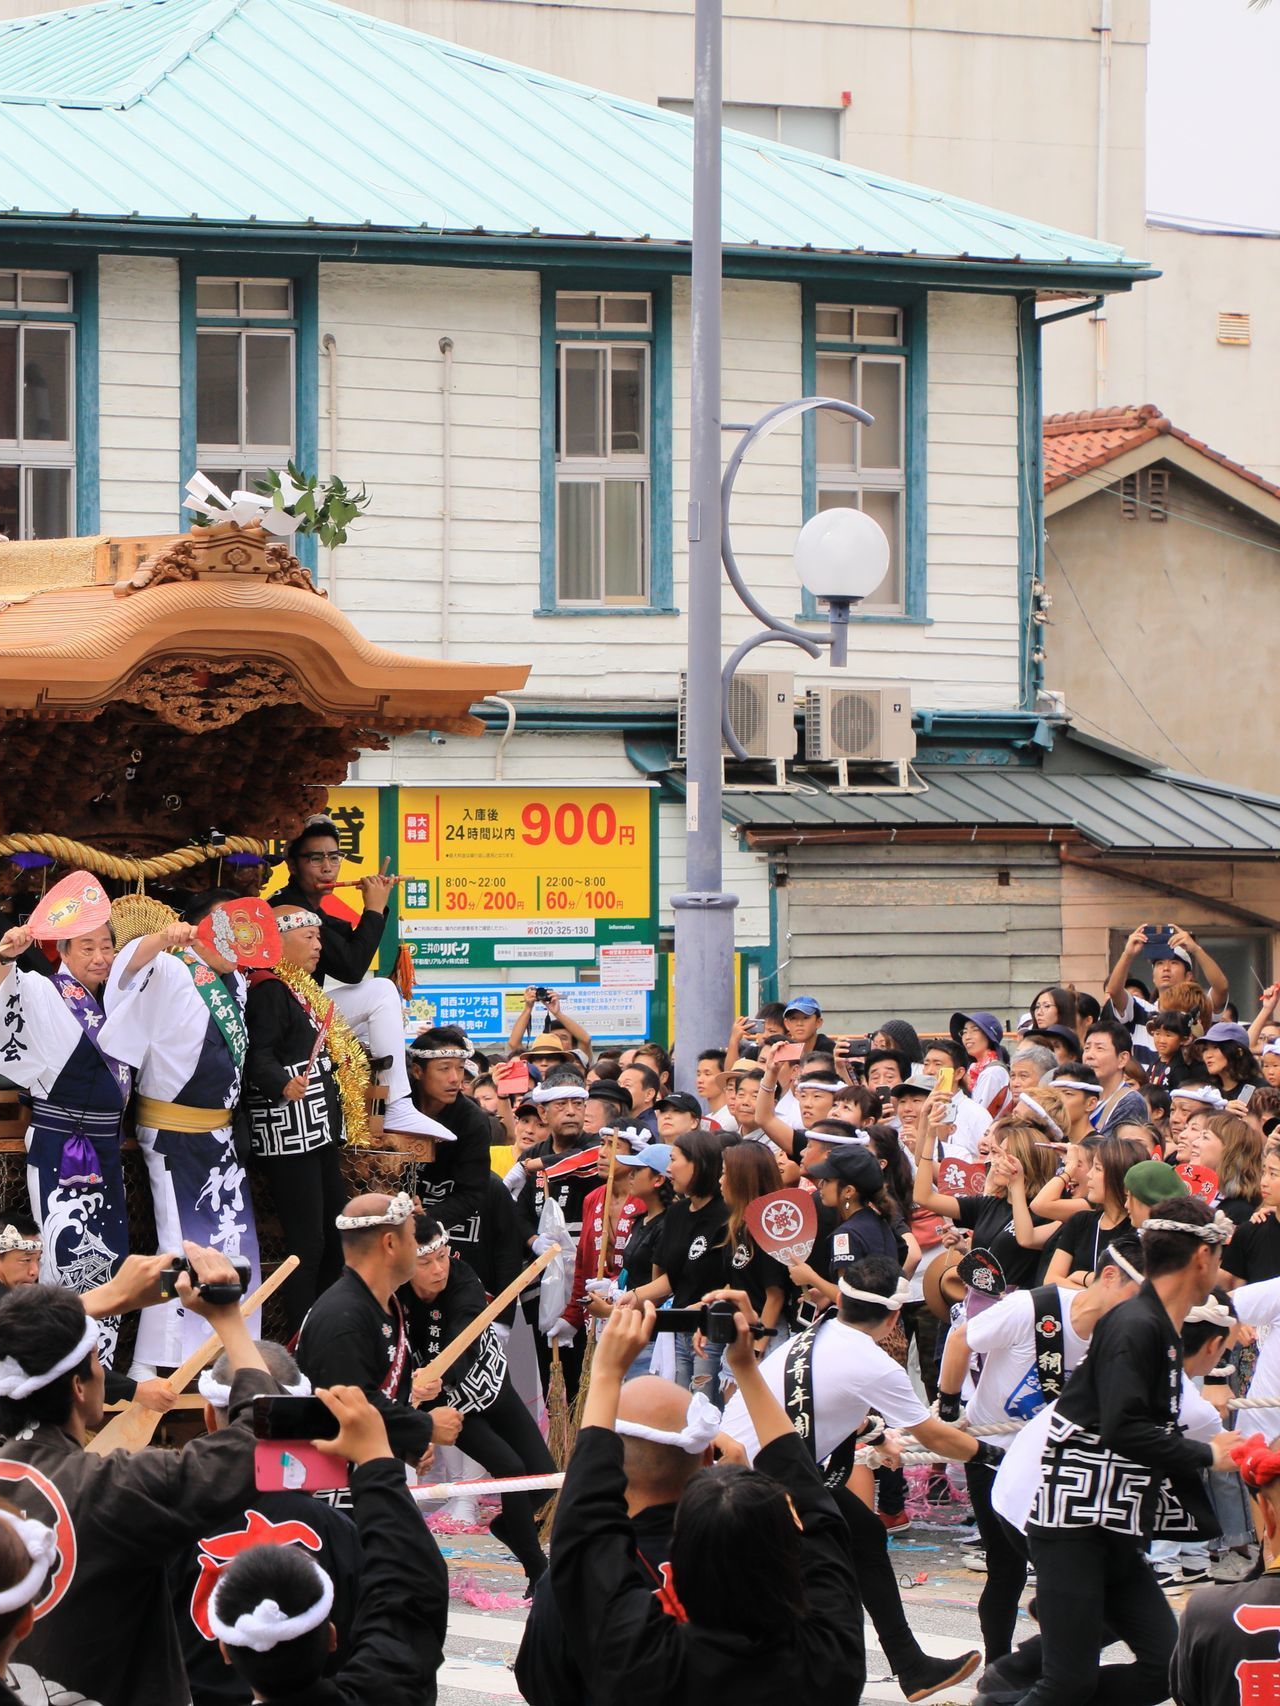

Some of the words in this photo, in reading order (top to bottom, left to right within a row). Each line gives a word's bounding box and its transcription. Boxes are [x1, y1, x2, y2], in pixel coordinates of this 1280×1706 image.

[462, 808, 499, 821] 入庫後
[407, 816, 427, 828] 最大
[407, 829, 427, 841] 料金
[445, 824, 516, 841] 24時間以内
[407, 882, 427, 894] 通常
[407, 895, 427, 907] 料金
[534, 926, 589, 935] 0120-325-130
[420, 942, 470, 956] 三井のリパーク
[440, 996, 498, 1007] 関西エリア共通
[440, 1008, 499, 1019] 駐車サービス券
[1182, 1165, 1214, 1193] 大工方
